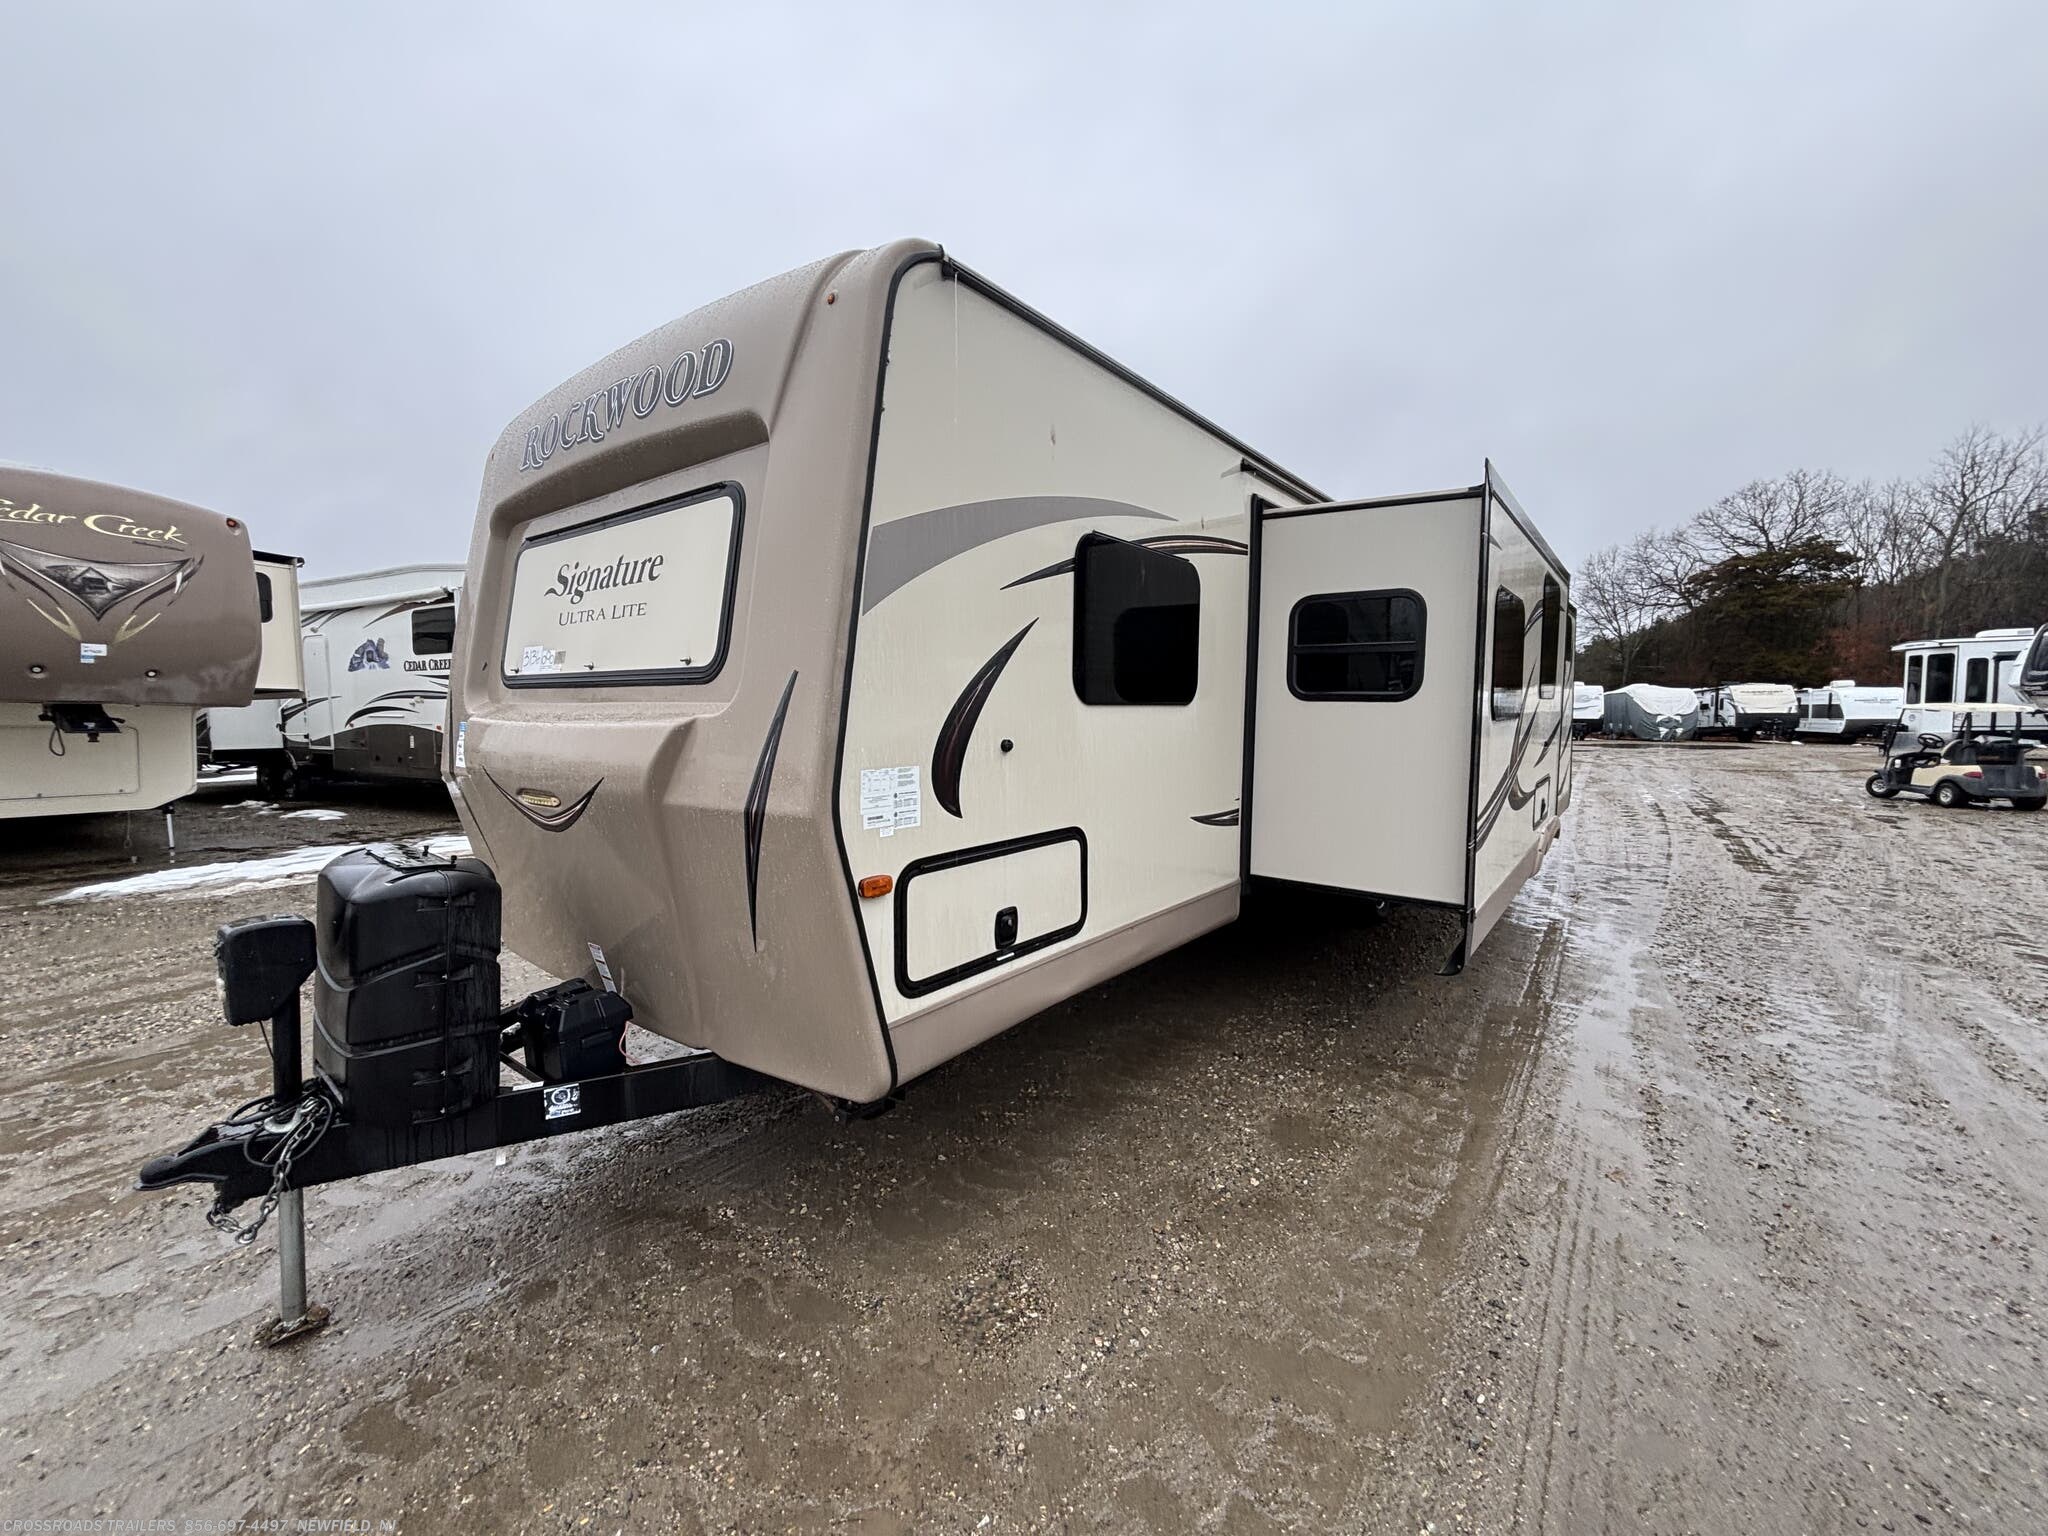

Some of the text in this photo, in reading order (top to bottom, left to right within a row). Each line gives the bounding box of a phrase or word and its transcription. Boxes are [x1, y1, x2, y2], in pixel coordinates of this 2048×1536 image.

[519, 338, 734, 472] ROCKWOOD
[84, 514, 188, 545] Creek
[544, 553, 664, 605] Signature
[558, 602, 648, 627] ULTRA LITE
[403, 660, 428, 672] CEDAR
